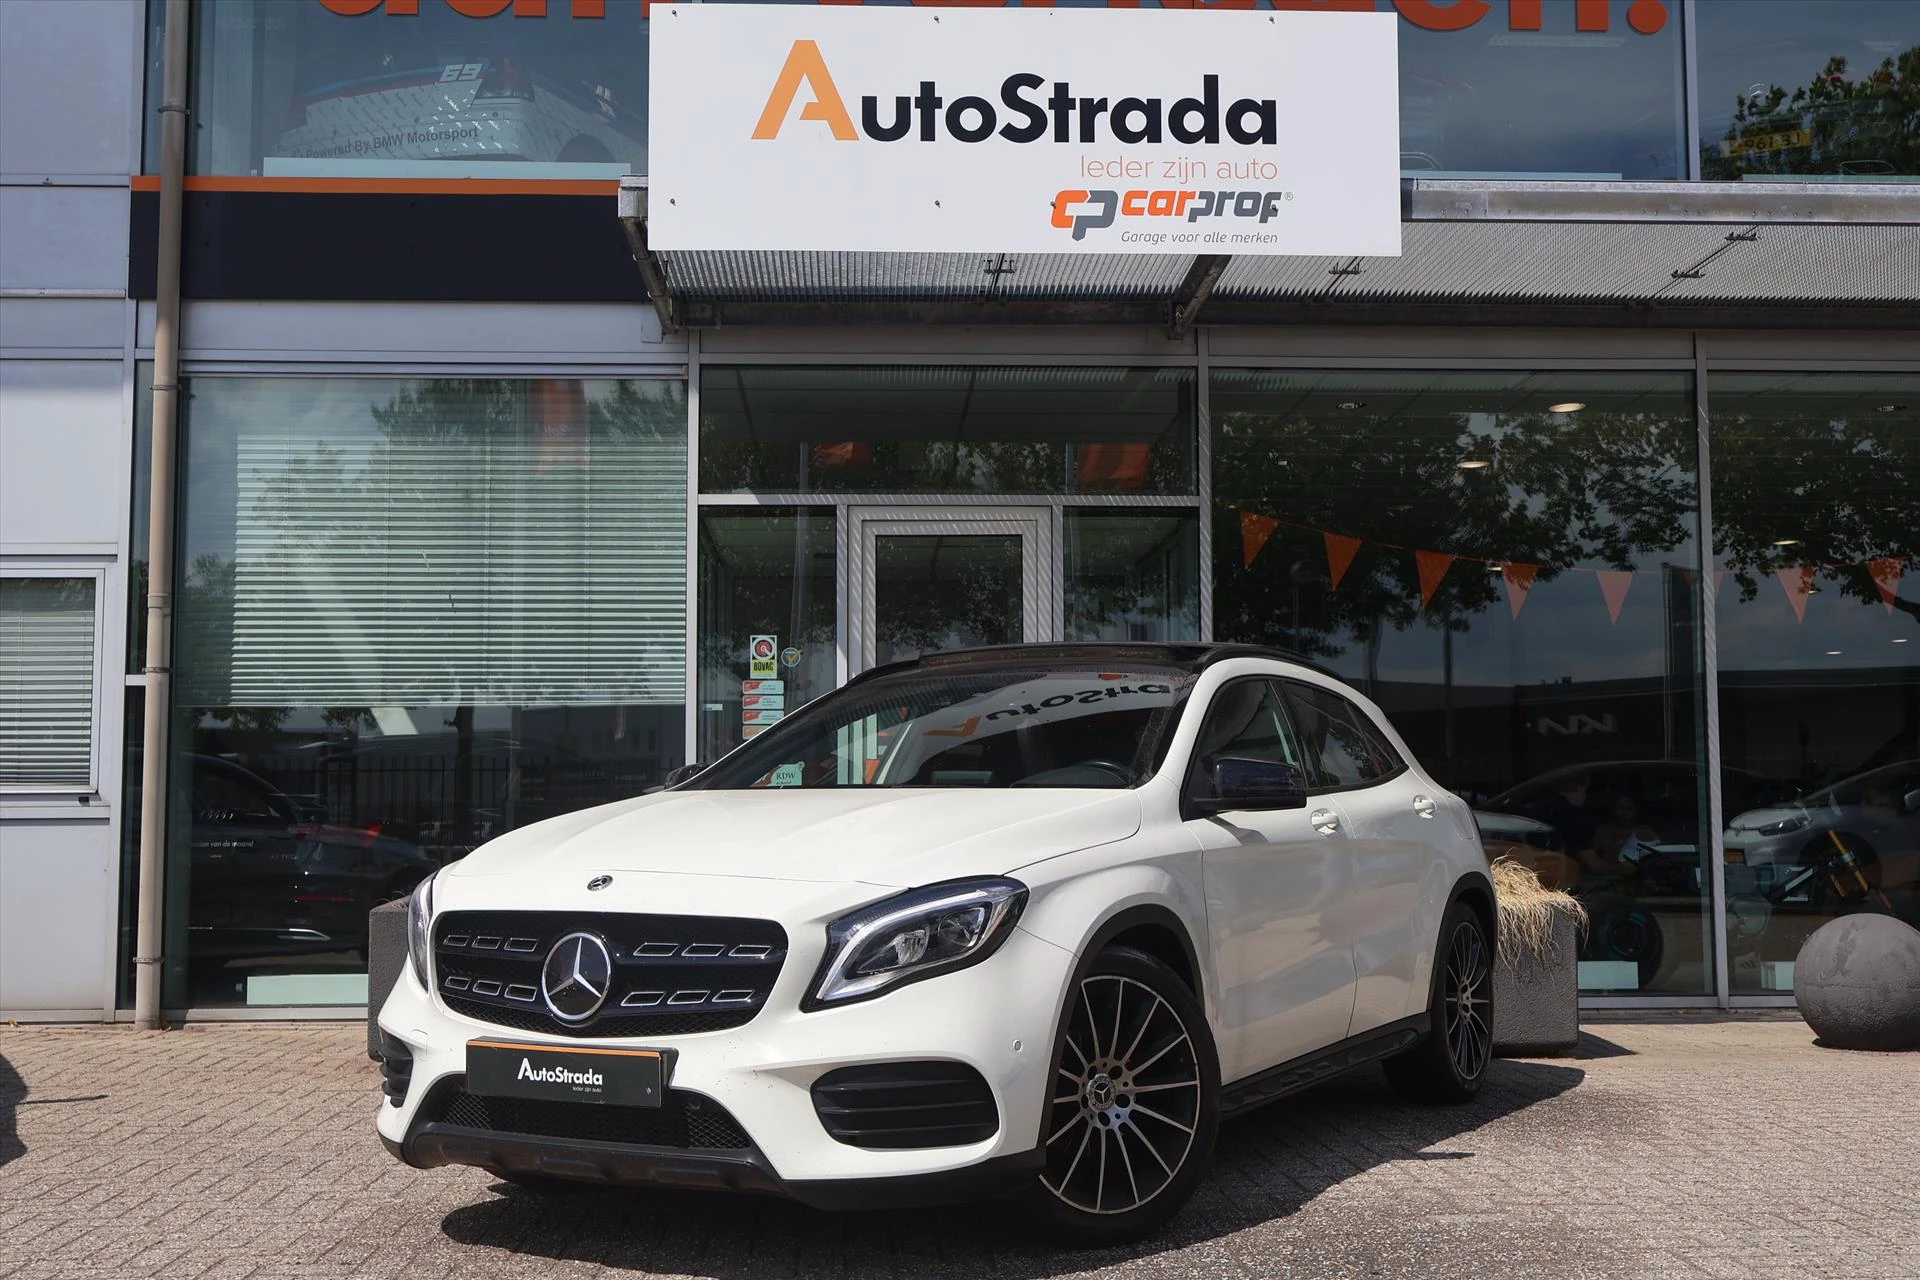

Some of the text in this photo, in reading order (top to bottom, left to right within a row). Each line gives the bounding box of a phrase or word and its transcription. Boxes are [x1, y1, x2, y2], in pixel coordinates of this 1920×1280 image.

[439, 64, 483, 82] 69
[751, 39, 1277, 144] AutoStrada
[306, 126, 479, 158] Powered By BMW Motorsport
[1081, 155, 1278, 184] Ieder zijn auto
[1121, 190, 1282, 223] carprof
[1121, 231, 1278, 245] Garage voor alle merken
[776, 772, 796, 780] RDW
[517, 1057, 603, 1085] AutoStrada
